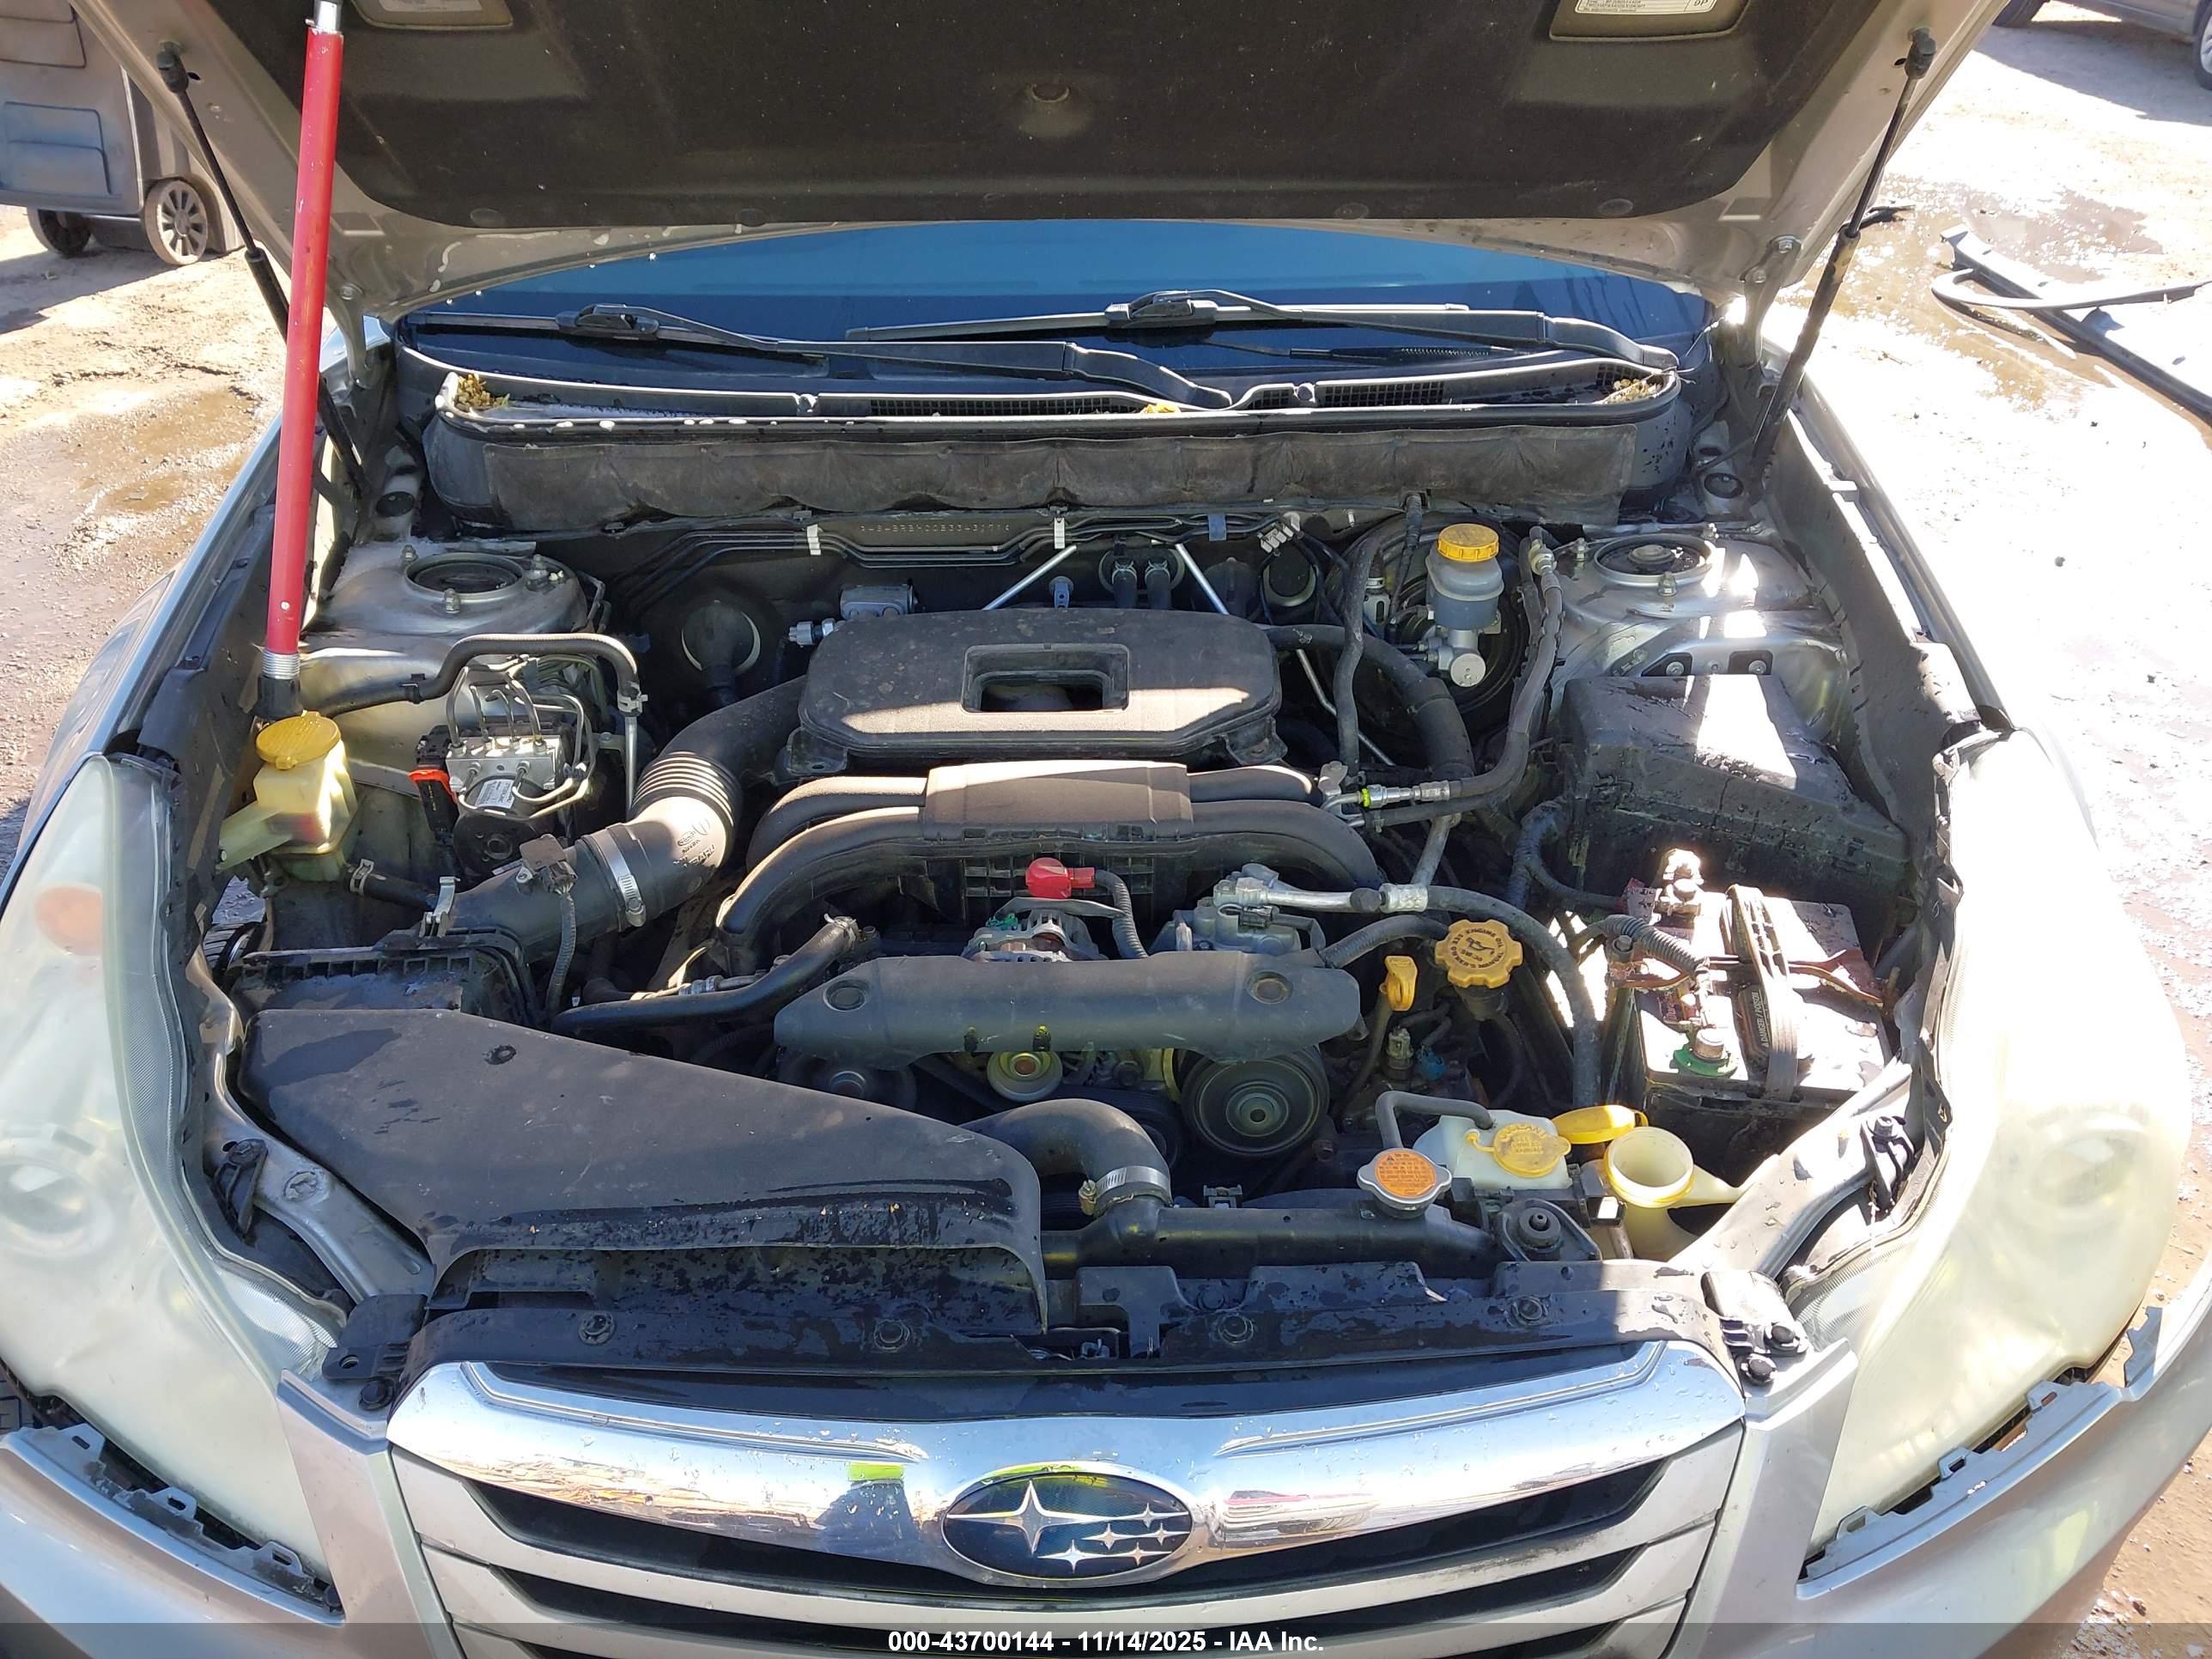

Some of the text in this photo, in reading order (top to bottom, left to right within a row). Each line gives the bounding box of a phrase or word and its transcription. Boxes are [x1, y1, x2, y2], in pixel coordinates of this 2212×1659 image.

[1452, 933, 1464, 945] SEE
[1466, 928, 1497, 938] ENGINE
[1751, 991, 1762, 1014] POISON
[1757, 1018, 1769, 1043] DANGER
